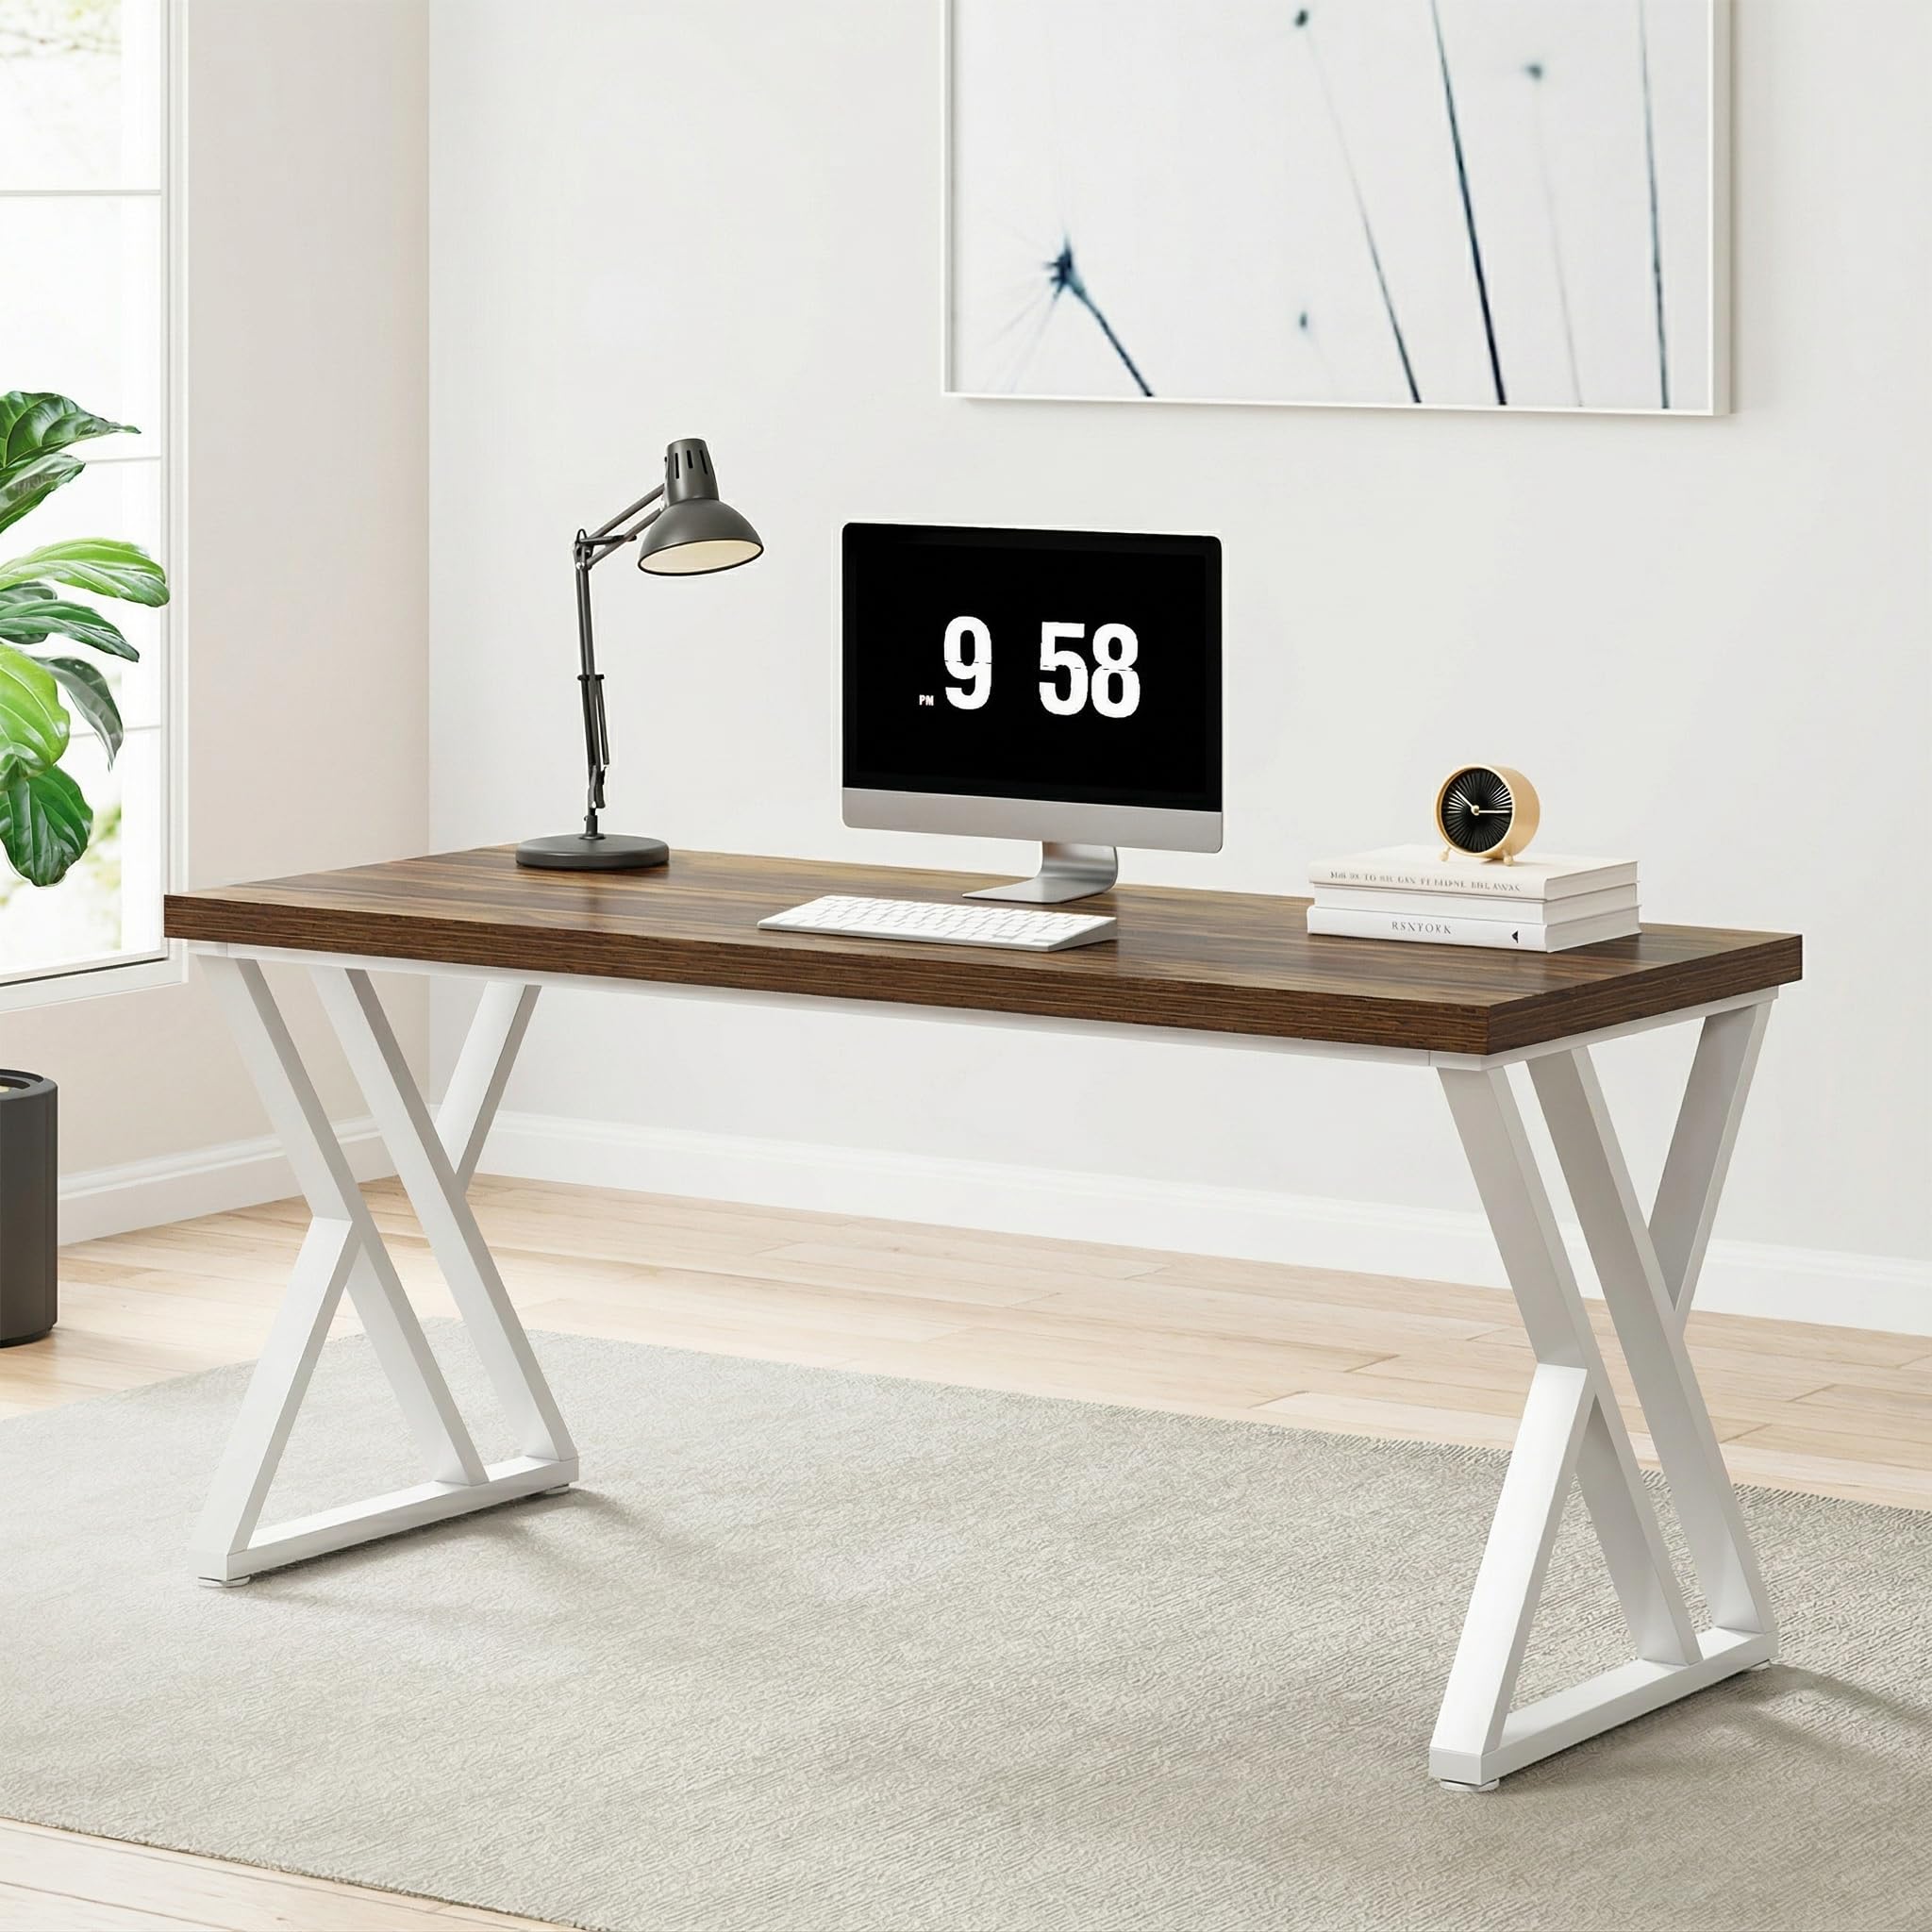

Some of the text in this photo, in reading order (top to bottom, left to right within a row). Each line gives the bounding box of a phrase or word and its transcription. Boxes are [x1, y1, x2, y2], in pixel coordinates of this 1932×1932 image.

[919, 615, 1141, 719] PM 9 58
